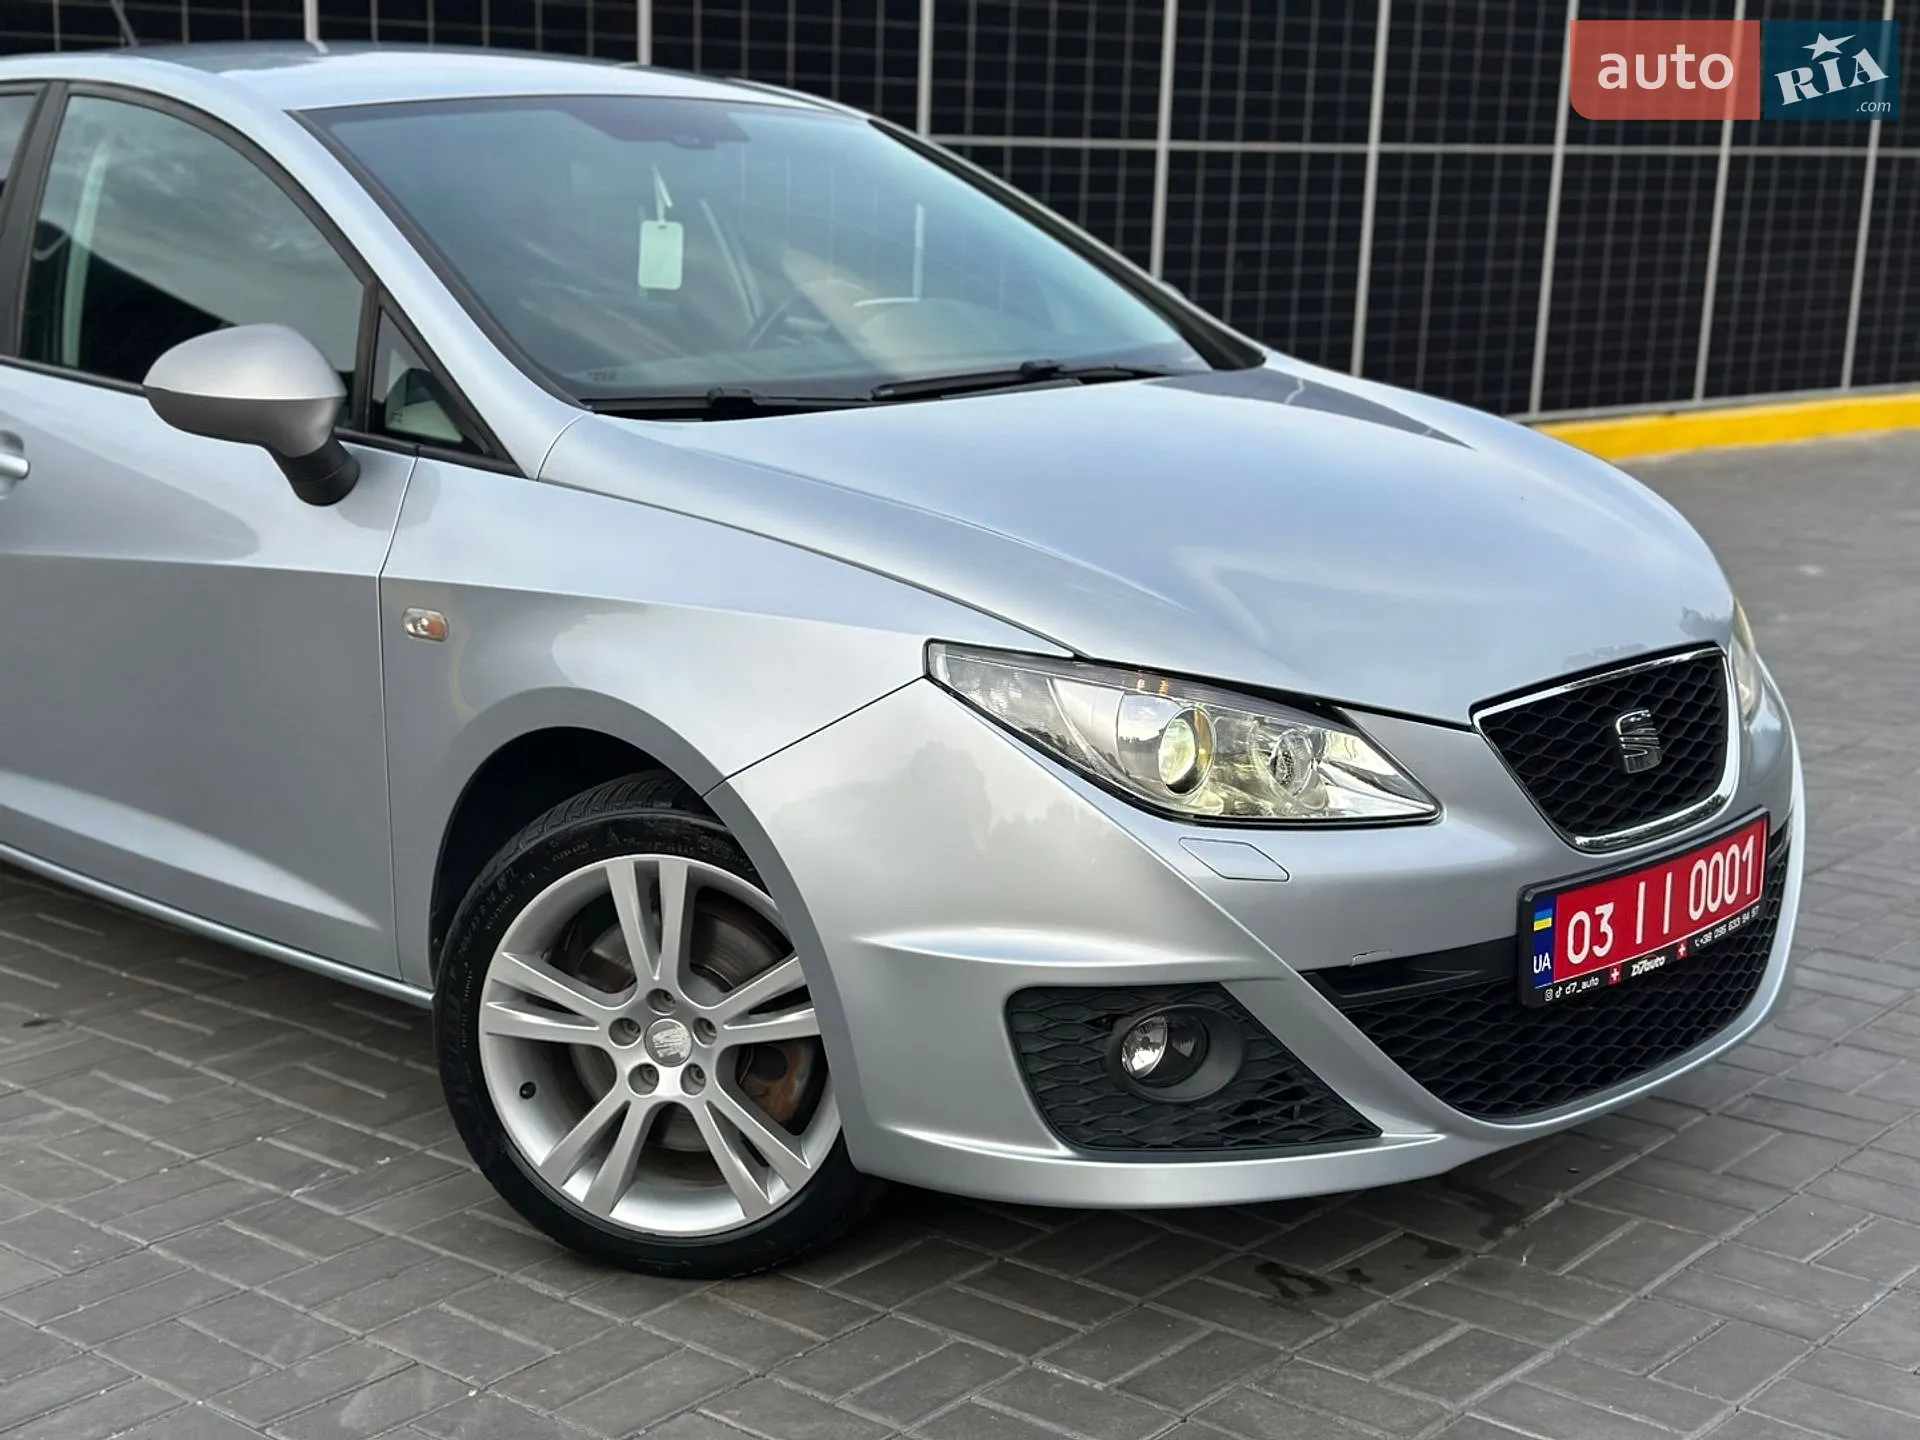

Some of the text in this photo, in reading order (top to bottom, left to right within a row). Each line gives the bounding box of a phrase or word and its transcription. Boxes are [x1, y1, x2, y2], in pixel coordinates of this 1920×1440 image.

[1566, 902, 1614, 965] 03
[1689, 835, 1754, 920] 0001
[1533, 953, 1551, 974] UA
